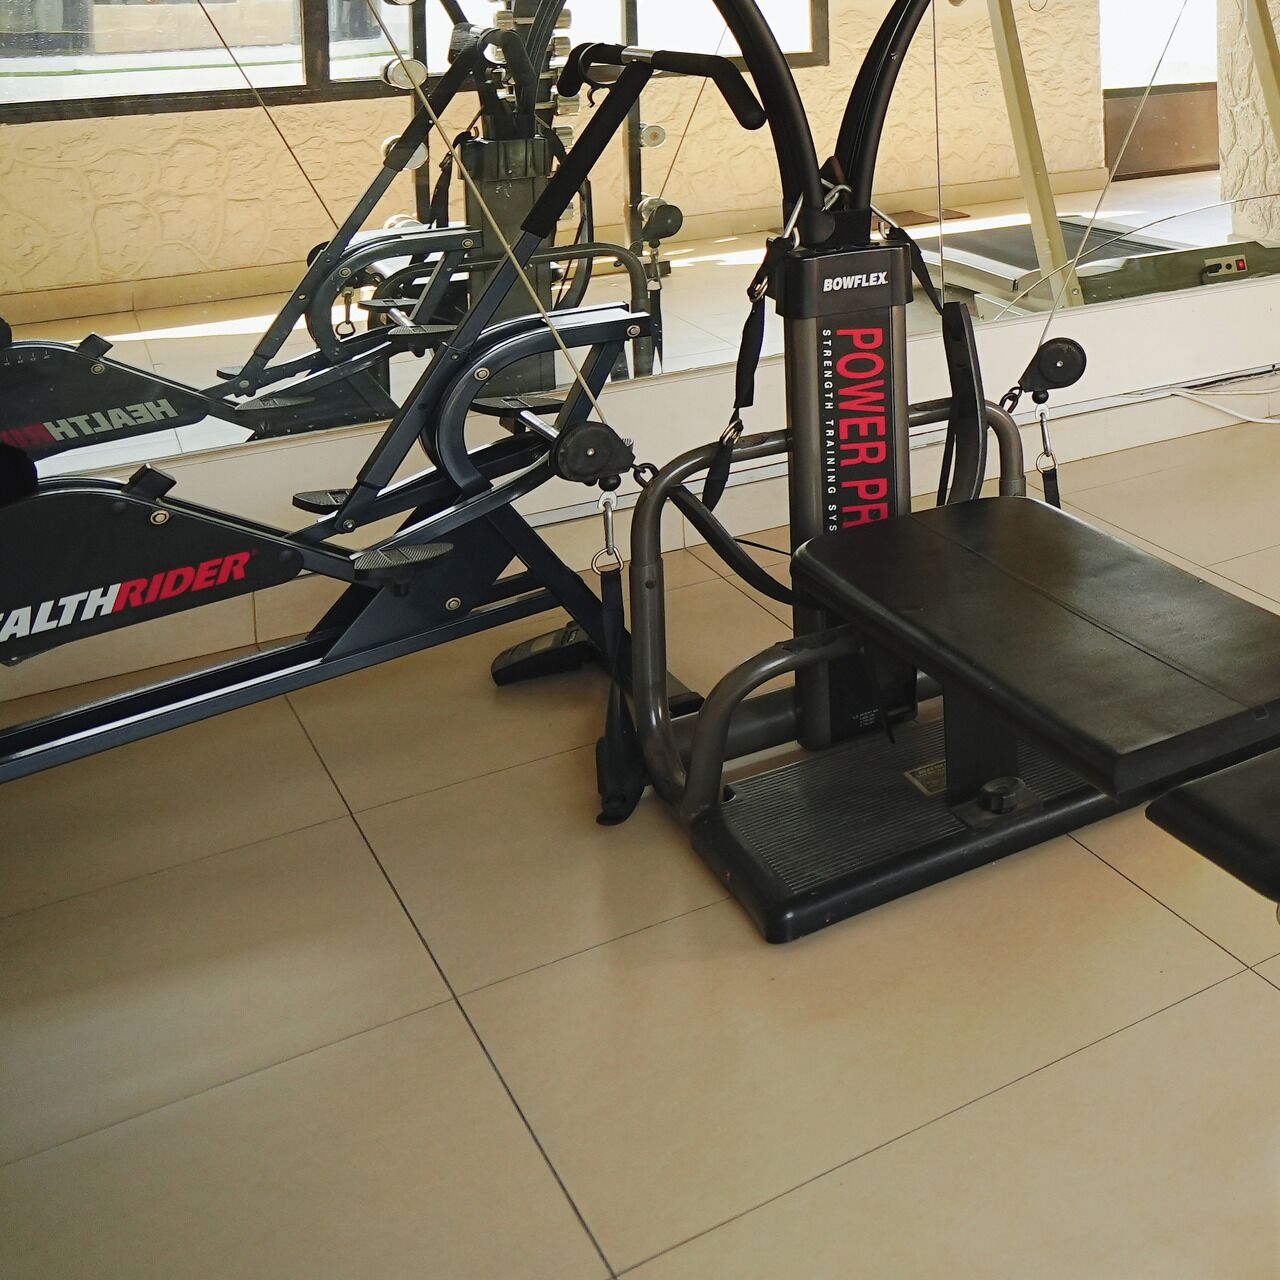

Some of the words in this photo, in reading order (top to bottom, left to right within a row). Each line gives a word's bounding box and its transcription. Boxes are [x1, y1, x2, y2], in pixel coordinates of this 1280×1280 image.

[823, 271, 888, 292] BOWFLEX
[822, 328, 834, 410] STRENGTH
[836, 327, 887, 467] POWER
[825, 420, 837, 495] TRAINING
[0, 551, 251, 643] ALTHRIDER
